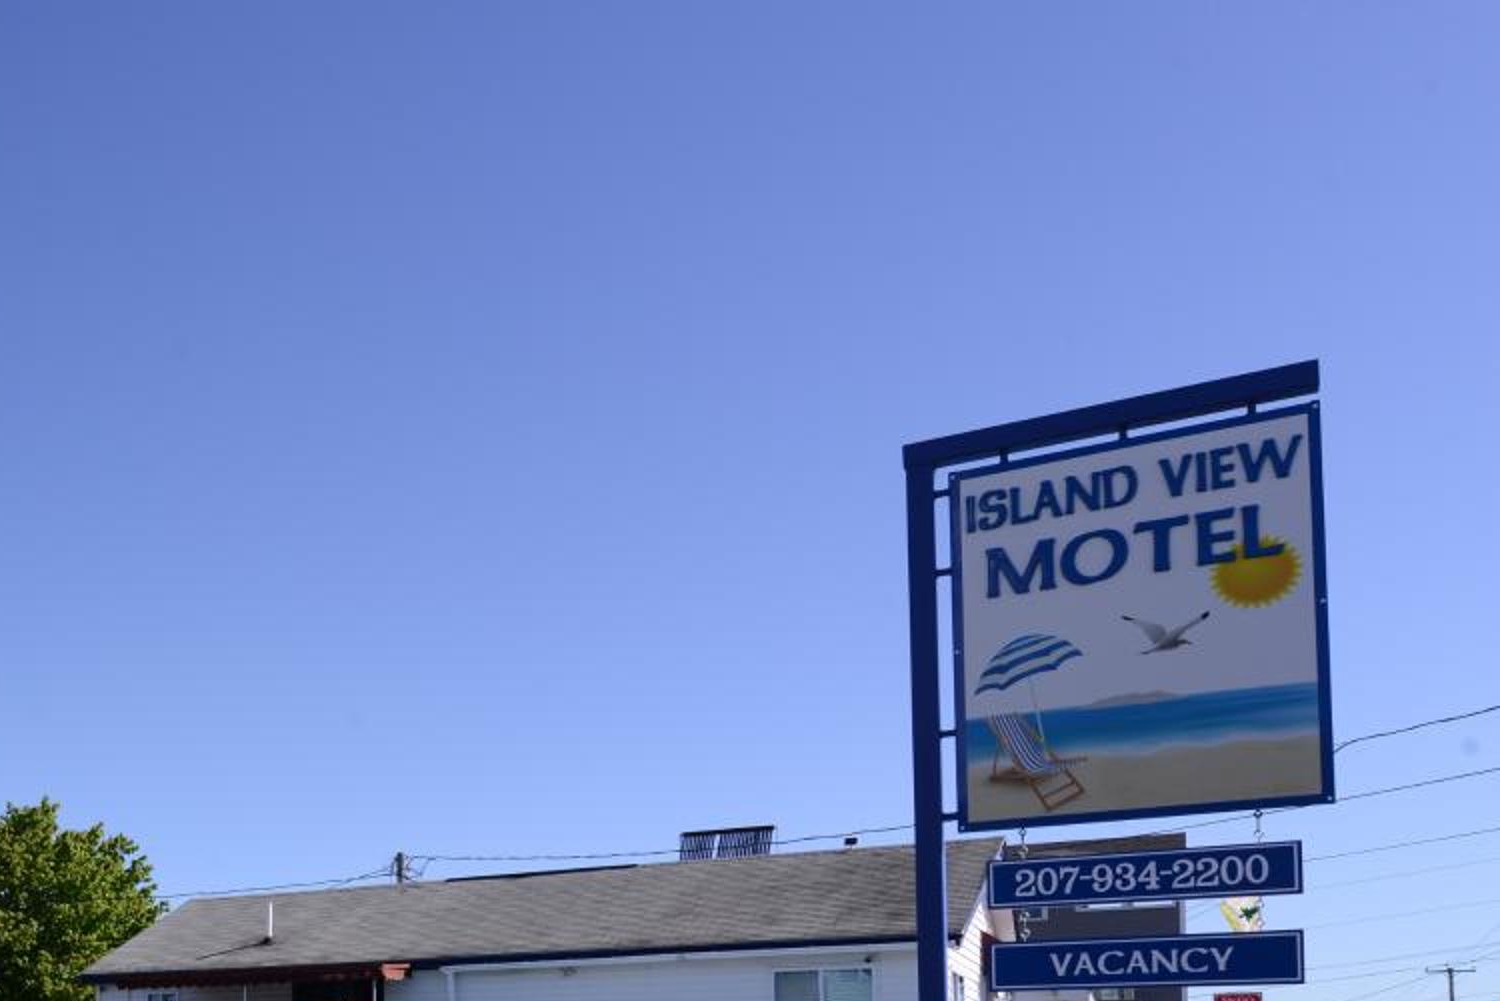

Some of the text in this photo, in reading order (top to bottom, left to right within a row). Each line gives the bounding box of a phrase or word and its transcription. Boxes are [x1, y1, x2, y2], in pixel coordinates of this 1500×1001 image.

[965, 434, 1304, 535] ISLAND VIEW
[985, 504, 1287, 600] MOTEL
[1014, 853, 1270, 898] 207-934-2200
[1049, 945, 1236, 978] VACANCY
